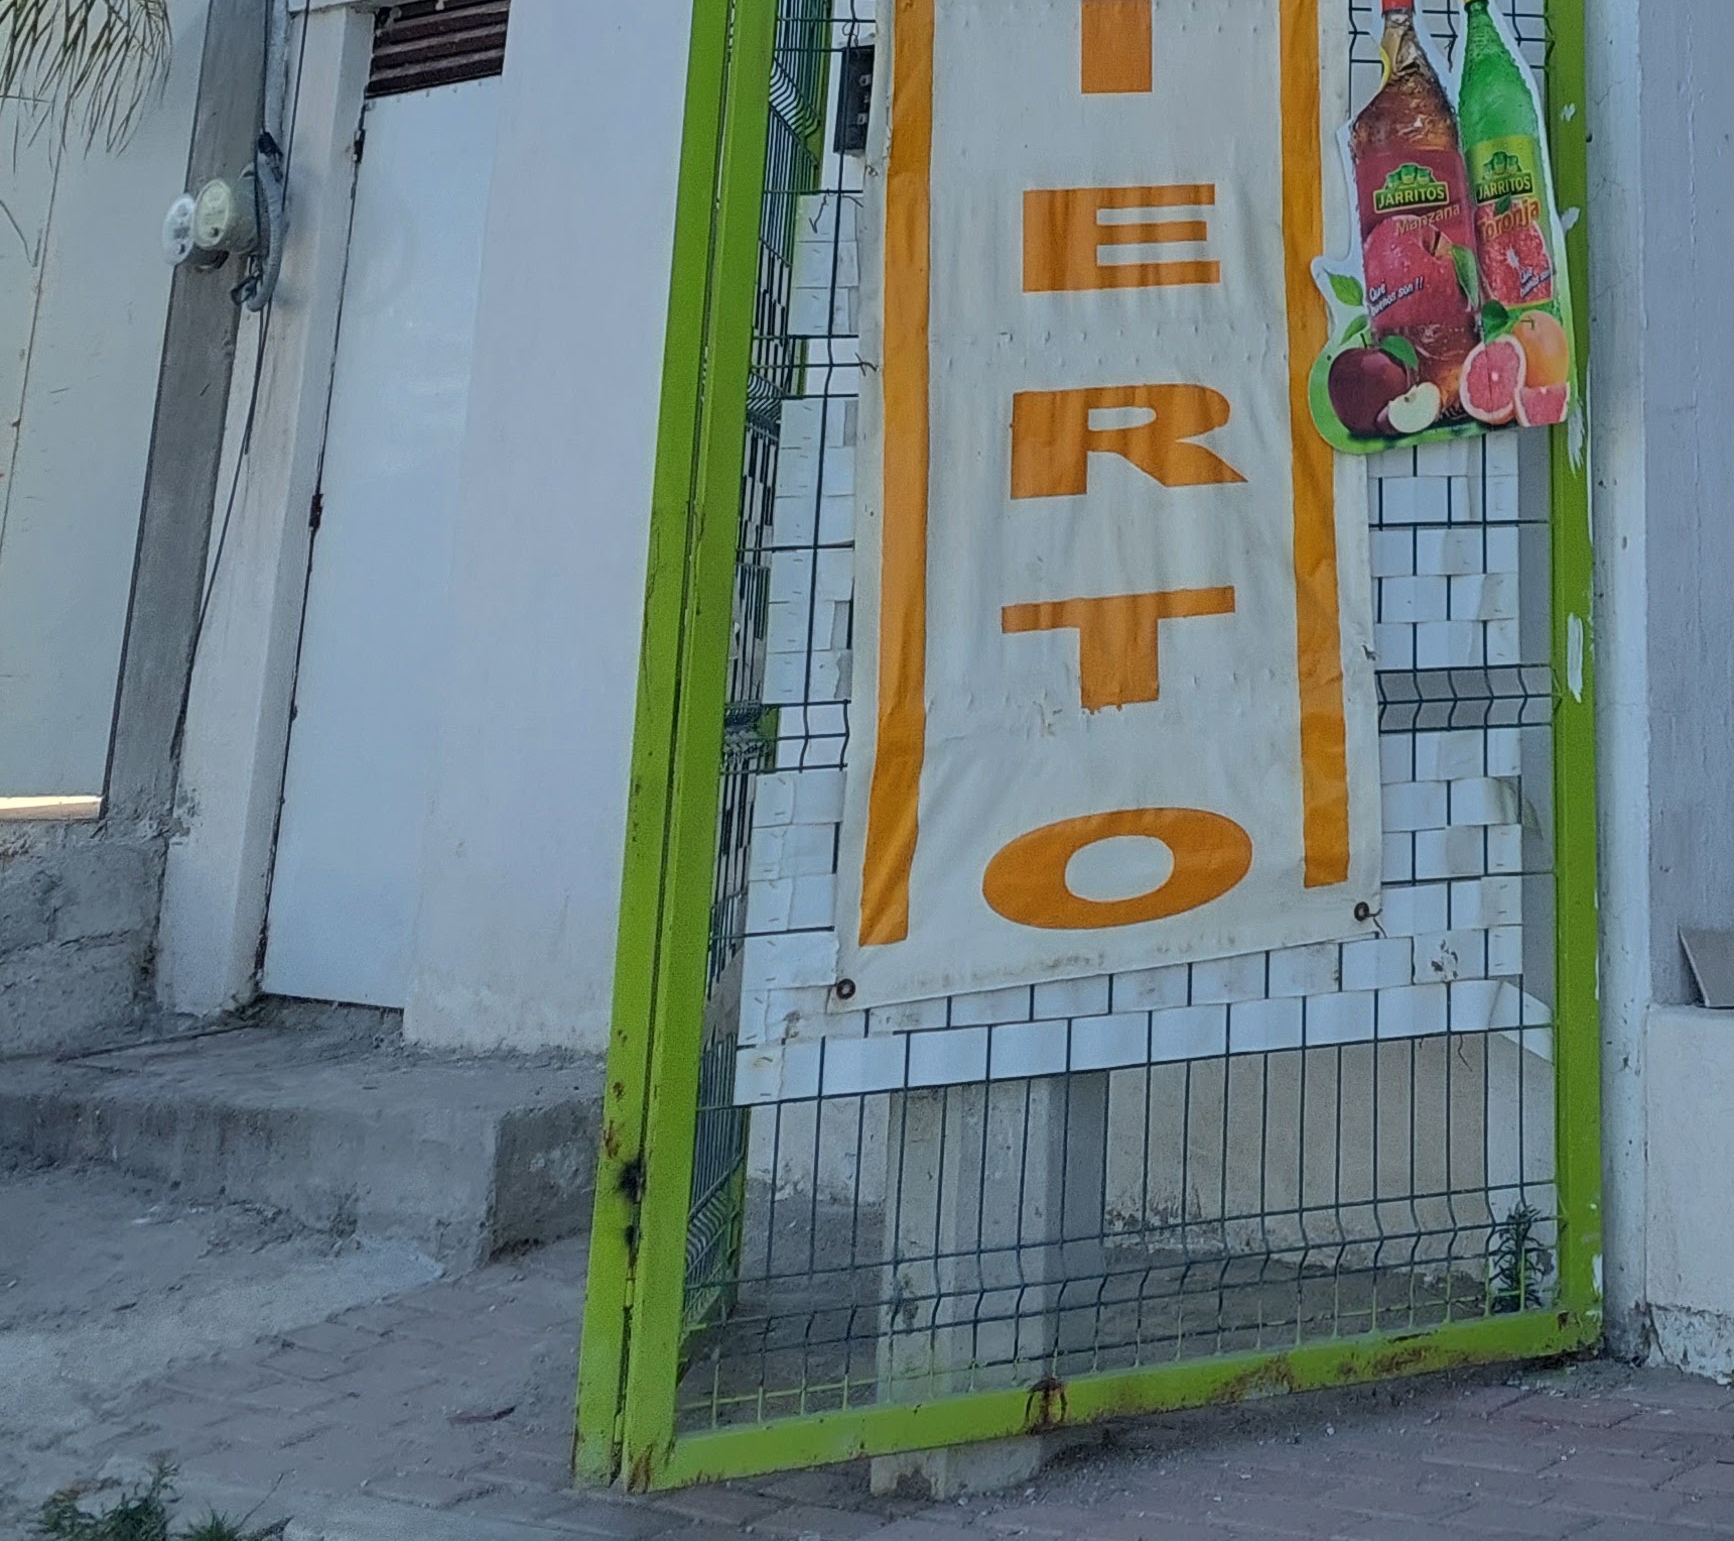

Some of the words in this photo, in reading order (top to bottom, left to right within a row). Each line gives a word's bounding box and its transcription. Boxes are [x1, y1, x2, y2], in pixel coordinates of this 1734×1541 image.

[1378, 185, 1446, 210] JARRITOS
[1477, 175, 1532, 201] JARRITOS
[1394, 203, 1462, 236] Manzana
